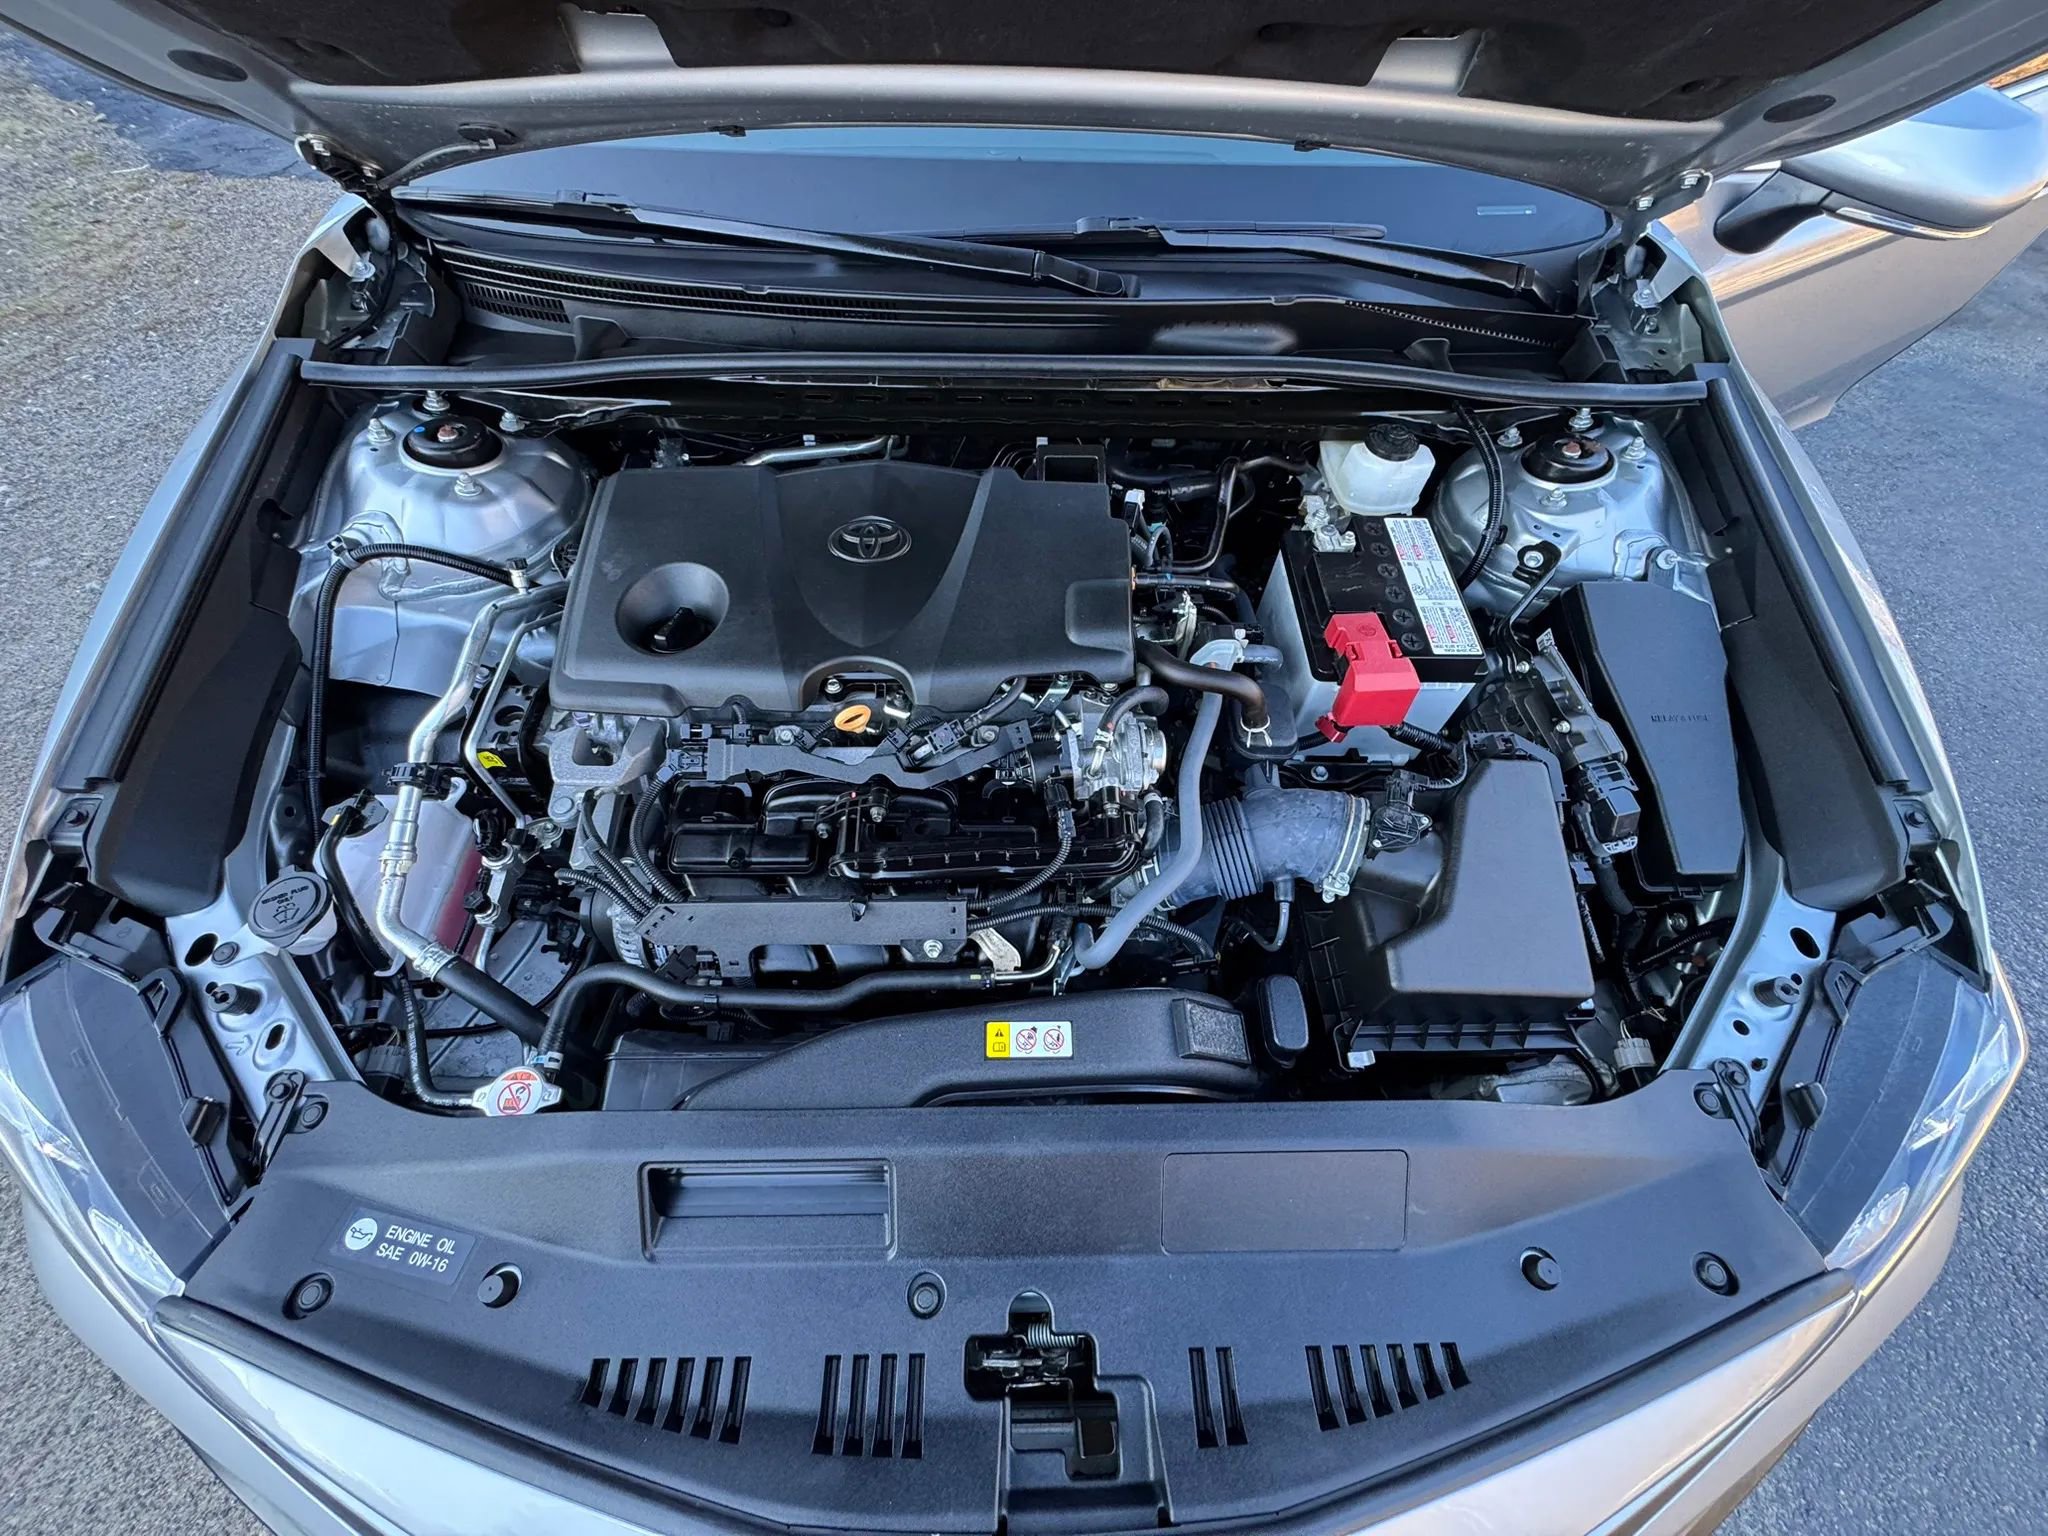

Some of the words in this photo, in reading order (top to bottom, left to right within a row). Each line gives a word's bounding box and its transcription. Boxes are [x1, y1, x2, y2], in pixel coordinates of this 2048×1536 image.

[385, 1225, 433, 1248] ENGINE
[436, 1238, 456, 1255] OIL
[376, 1242, 405, 1261] SAE
[408, 1251, 449, 1273] 0W-16
